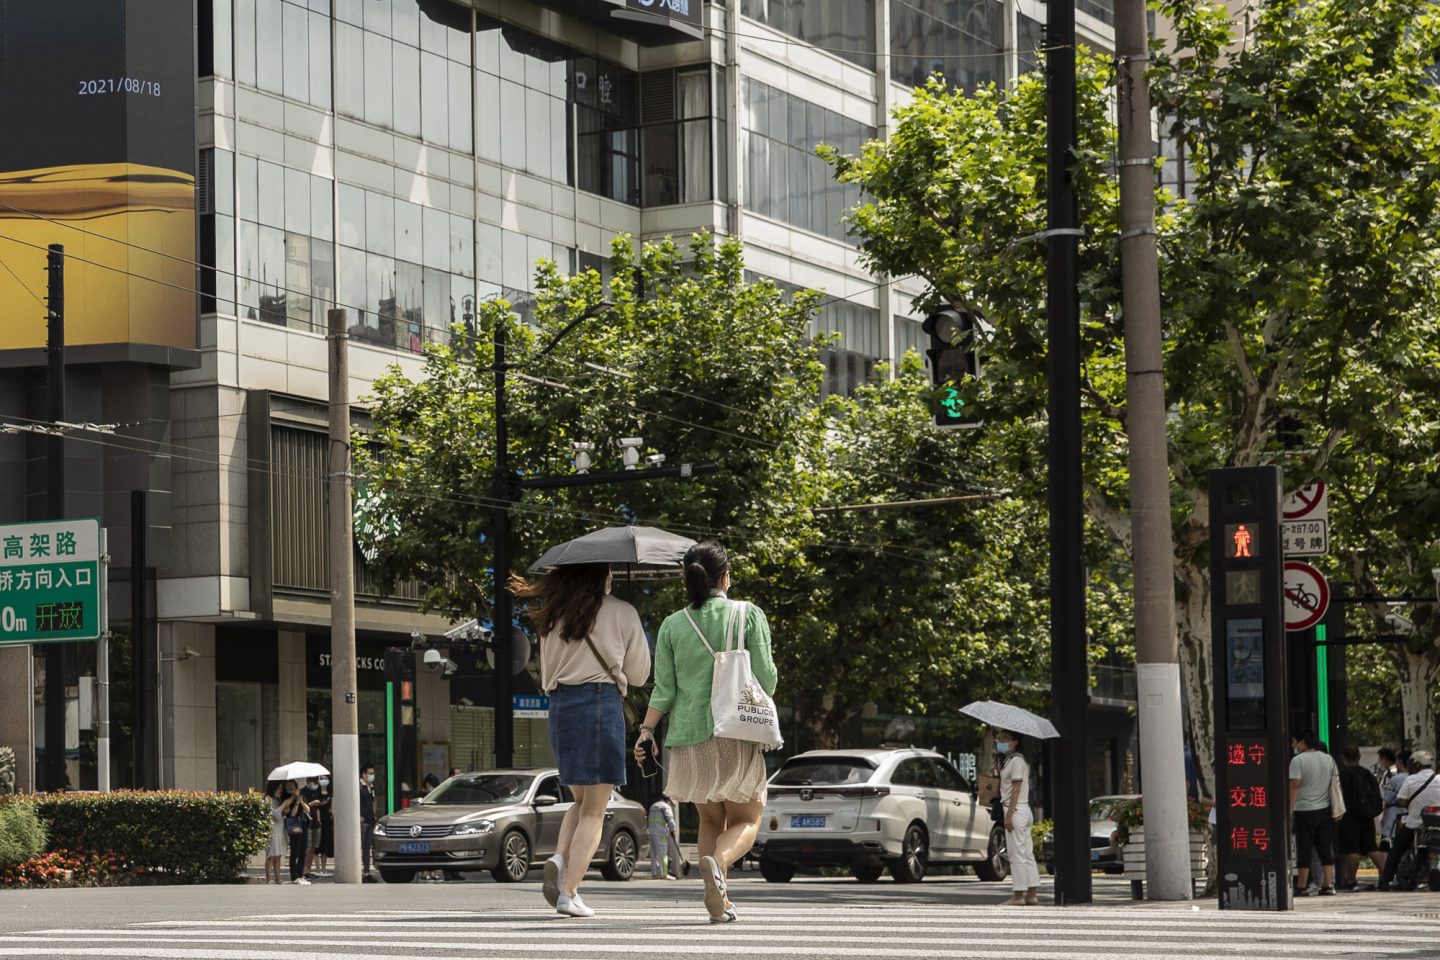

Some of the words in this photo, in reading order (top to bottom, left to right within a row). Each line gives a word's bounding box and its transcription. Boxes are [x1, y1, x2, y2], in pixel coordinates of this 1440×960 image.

[78, 78, 161, 97] 2021/08/18
[36, 602, 82, 632] 开放
[320, 654, 373, 669] STCKS
[737, 705, 774, 717] PUBLICIS
[739, 715, 774, 726] GROUPE
[1228, 743, 1266, 765] 遵守
[1230, 785, 1267, 807] 交通
[1231, 826, 1271, 850] 信号
